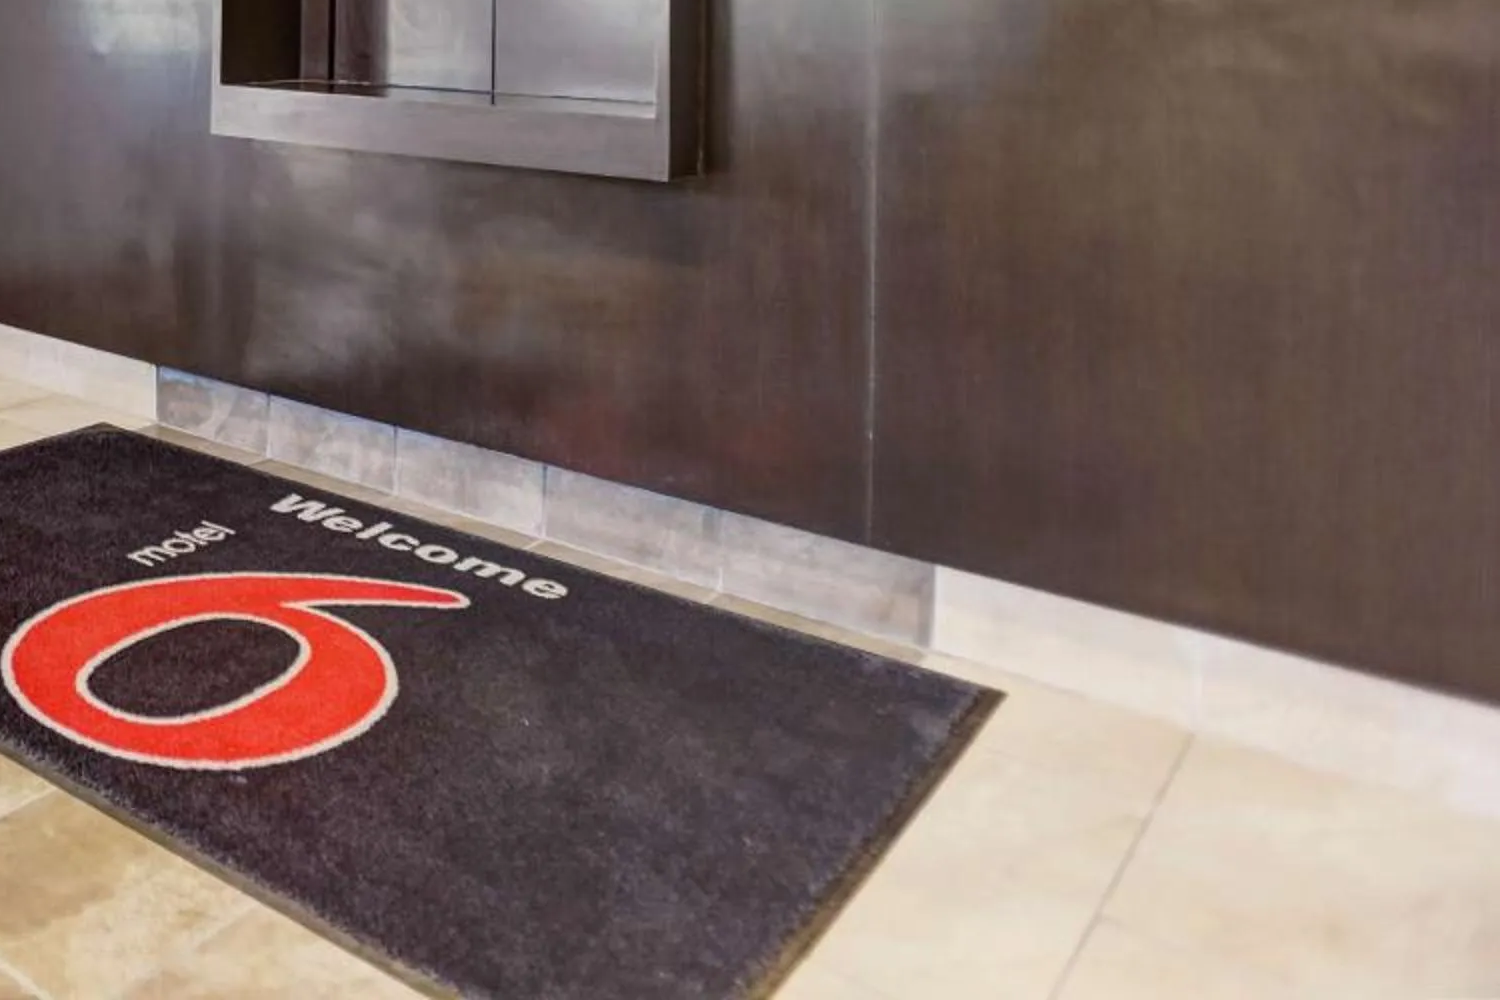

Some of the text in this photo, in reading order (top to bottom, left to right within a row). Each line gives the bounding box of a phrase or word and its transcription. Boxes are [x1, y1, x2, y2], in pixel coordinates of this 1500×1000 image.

[127, 520, 237, 568] motel
[270, 493, 569, 601] Welcome
[0, 571, 471, 771] 6
